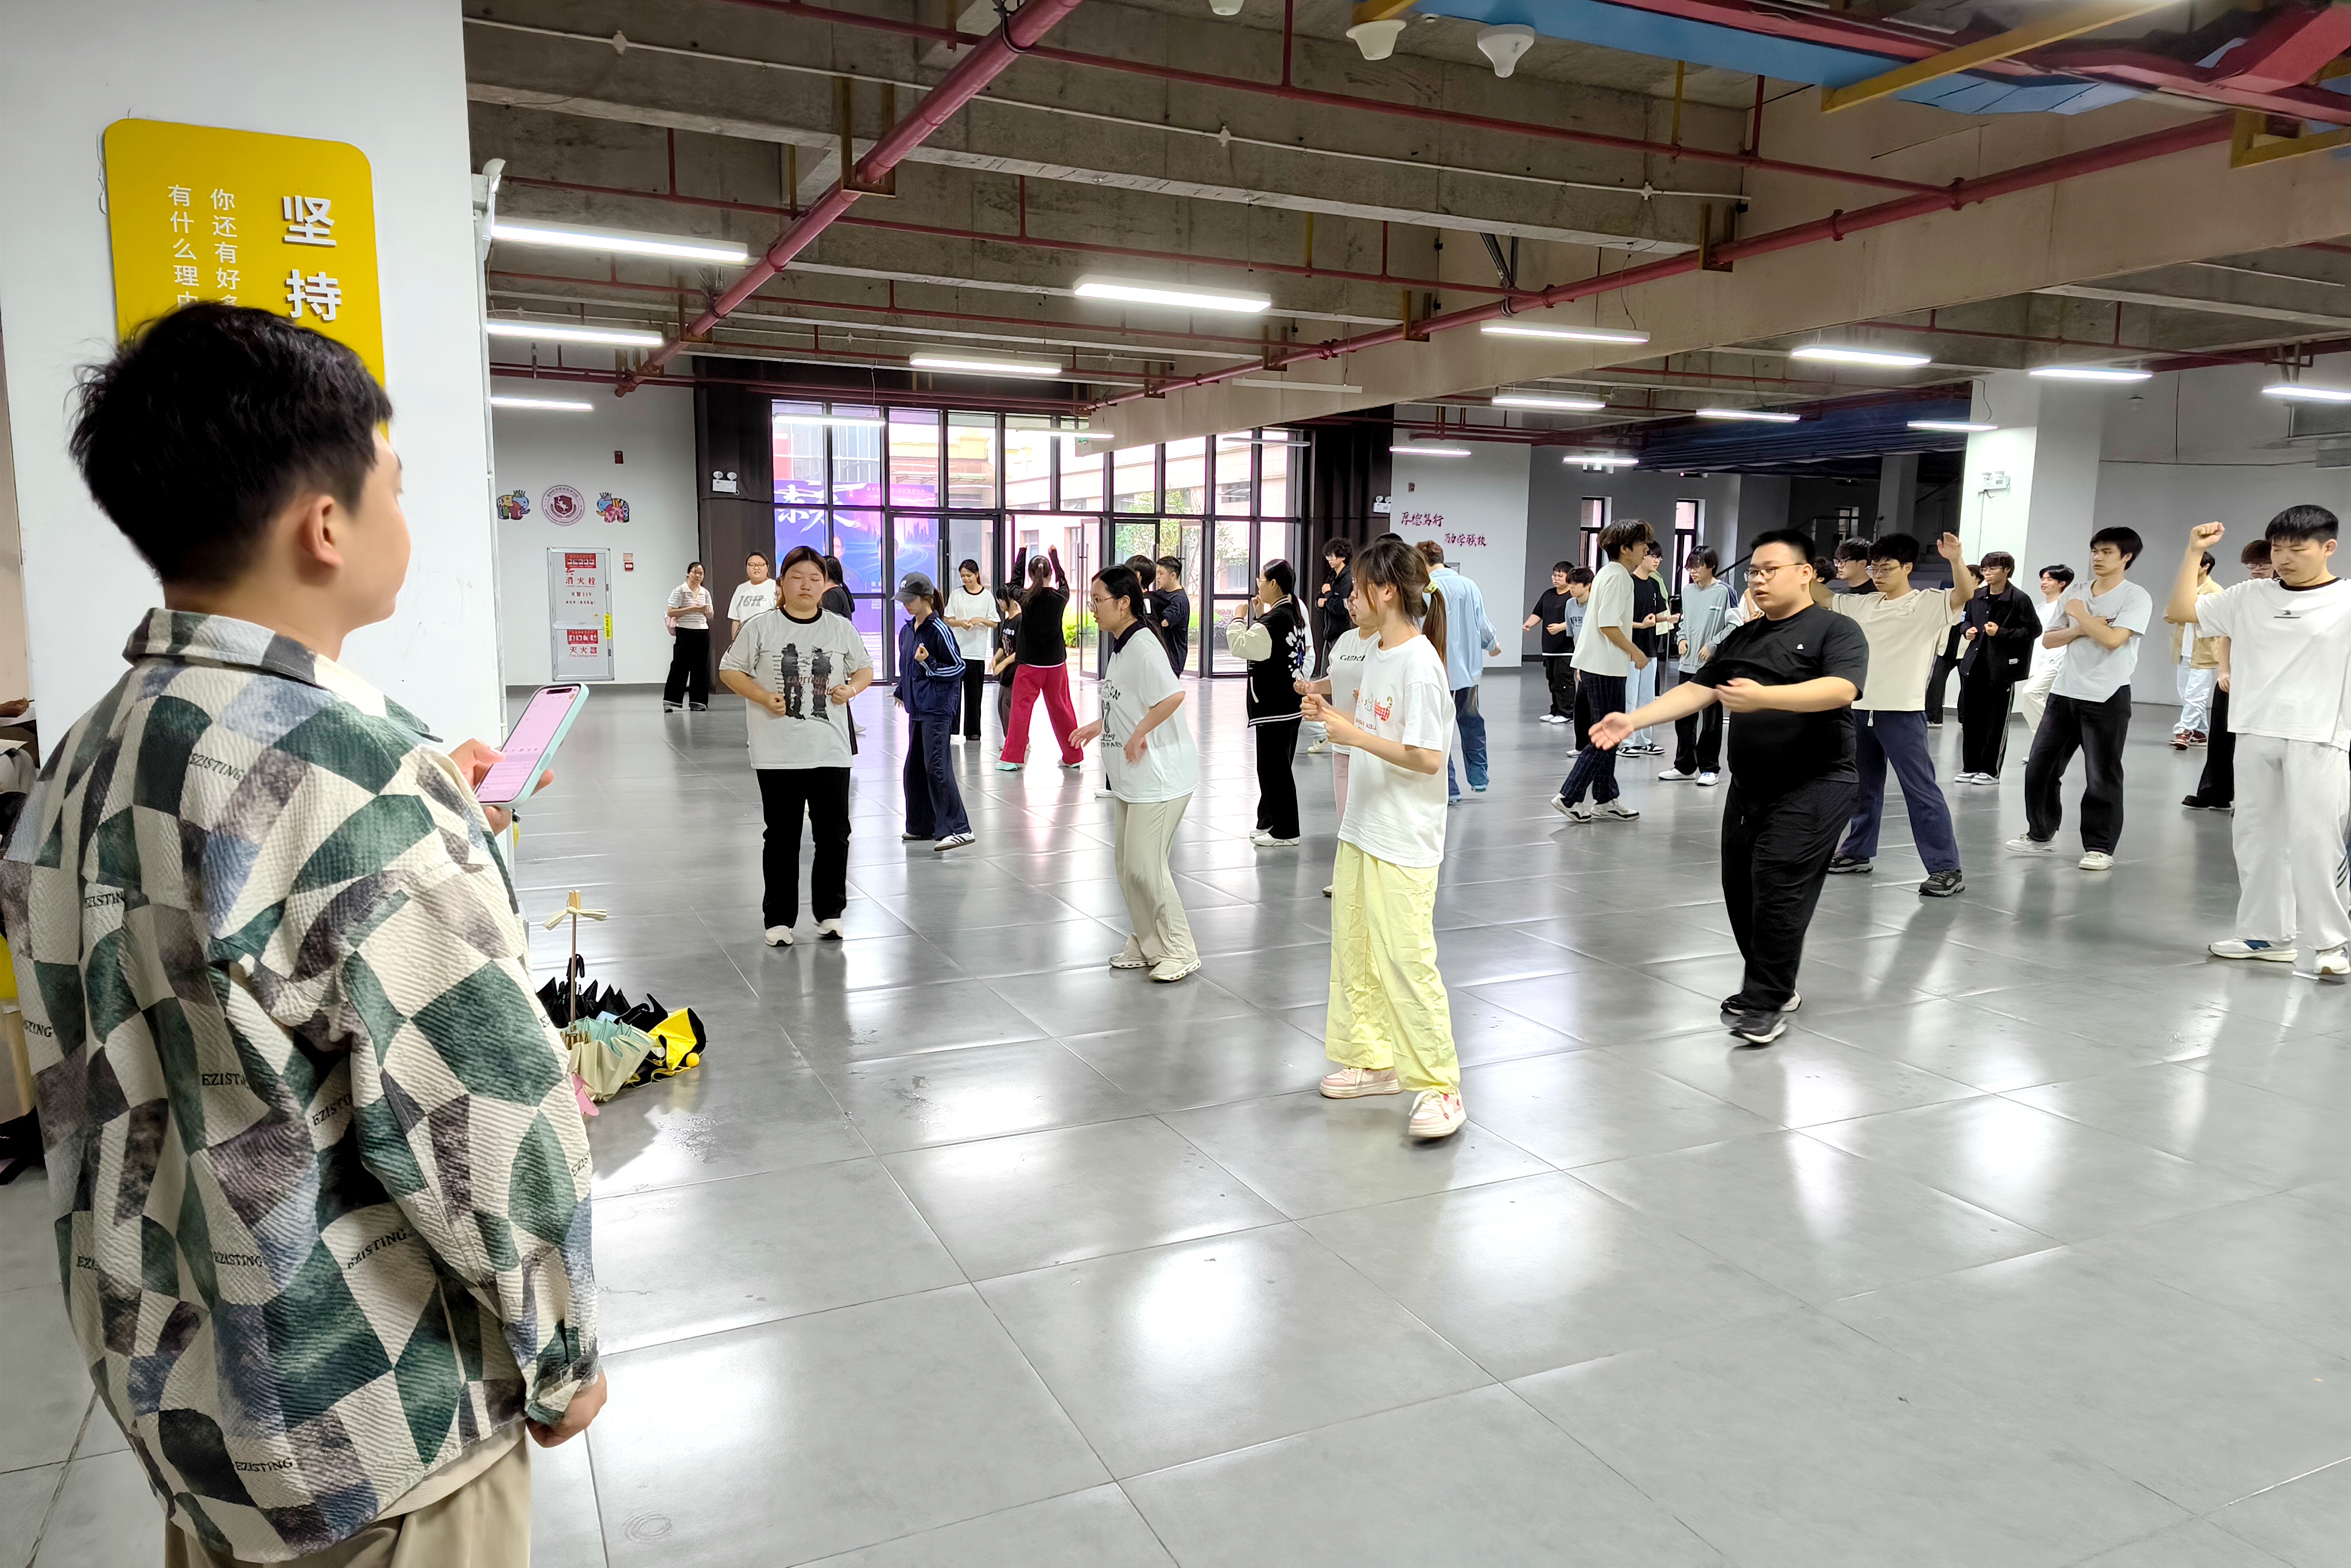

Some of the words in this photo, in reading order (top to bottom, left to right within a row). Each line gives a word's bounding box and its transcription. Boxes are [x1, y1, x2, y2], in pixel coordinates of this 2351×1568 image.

[282, 195, 342, 321] 坚持
[189, 753, 245, 781] EZISTING
[234, 1458, 293, 1473] EZISTING
